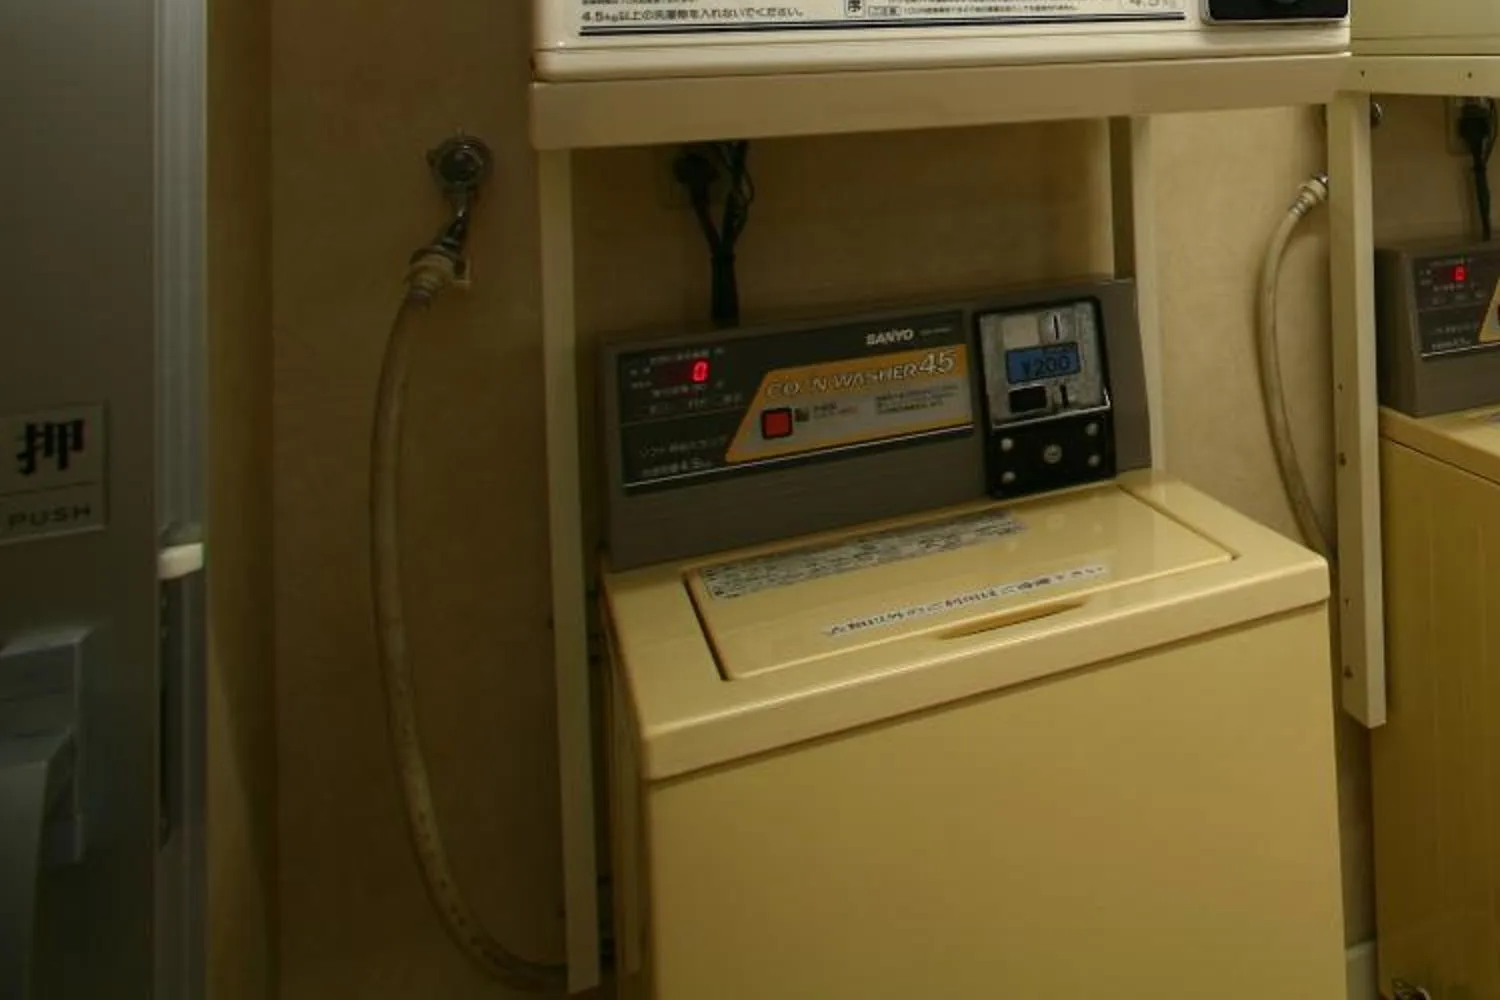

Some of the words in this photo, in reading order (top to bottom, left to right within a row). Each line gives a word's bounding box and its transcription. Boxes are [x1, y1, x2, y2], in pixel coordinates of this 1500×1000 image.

[865, 328, 915, 347] SANYO
[692, 359, 709, 383] 0
[766, 376, 828, 398] CON
[919, 351, 956, 375] 45
[16, 419, 85, 477] 押
[8, 503, 91, 529] PUSH
